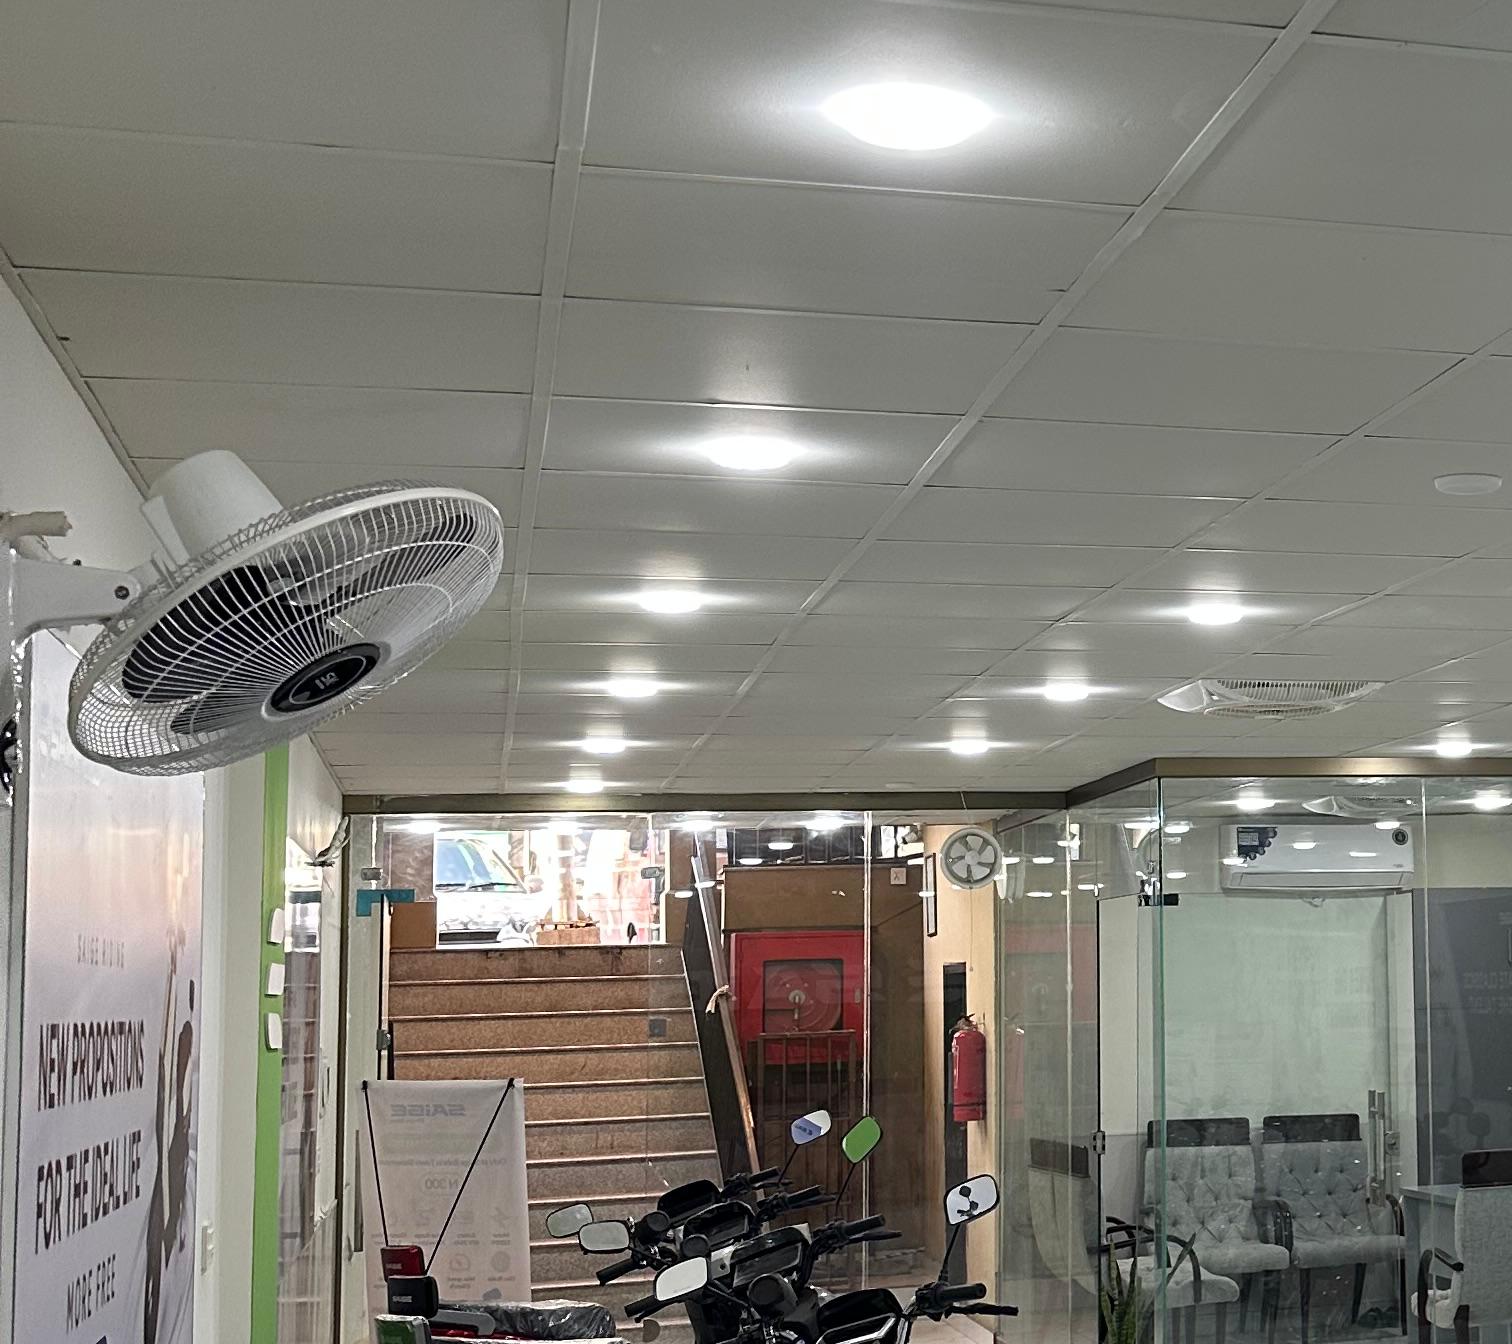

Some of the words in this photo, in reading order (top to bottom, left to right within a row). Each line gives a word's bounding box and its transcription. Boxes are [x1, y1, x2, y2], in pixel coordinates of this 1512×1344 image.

[38, 1022, 70, 1112] NEW
[71, 1019, 144, 1104] PROPOSITIONS
[35, 1159, 62, 1255] FOR
[66, 1148, 89, 1238] THE
[90, 1137, 120, 1224] IDEAL
[122, 1129, 142, 1206] LIFE
[66, 1269, 93, 1335] MORE
[95, 1253, 116, 1311] FREE
